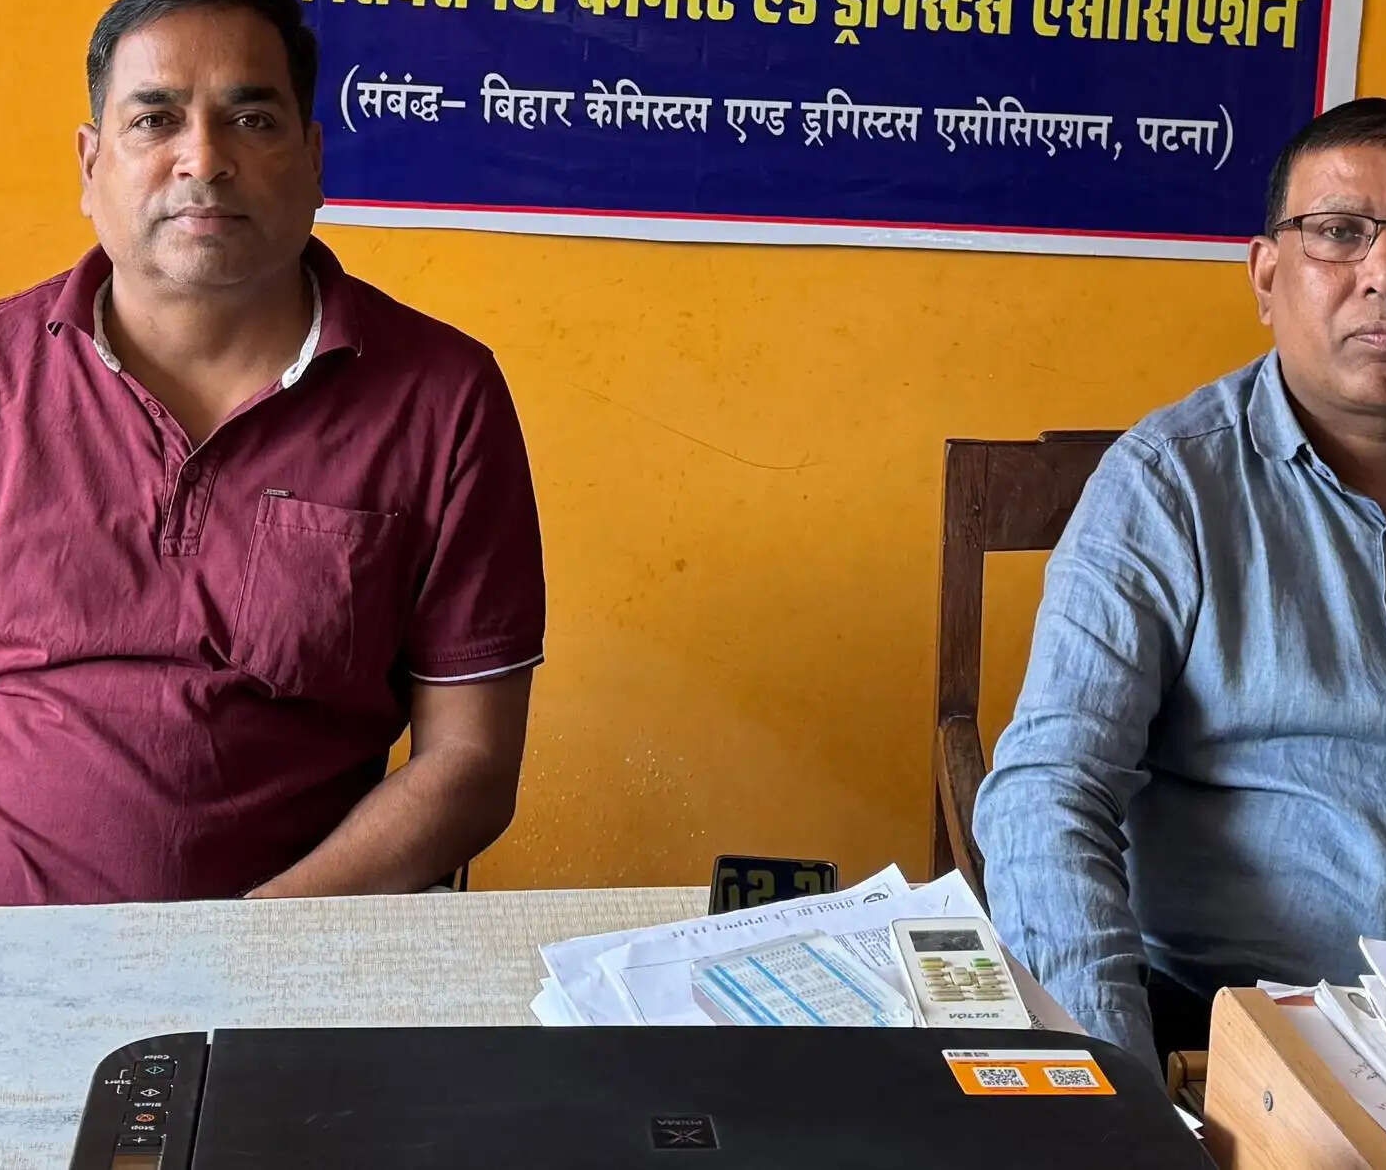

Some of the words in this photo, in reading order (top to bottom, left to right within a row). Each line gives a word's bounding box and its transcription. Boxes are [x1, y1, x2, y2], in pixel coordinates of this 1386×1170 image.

[480, 72, 575, 129] बिहार
[584, 79, 713, 133] केमिस्टस
[724, 97, 792, 143] एण्ड
[800, 87, 923, 147] ड्रगिस्टस
[934, 96, 1123, 161] एसोसिएशन,
[1136, 104, 1235, 171] पटना)
